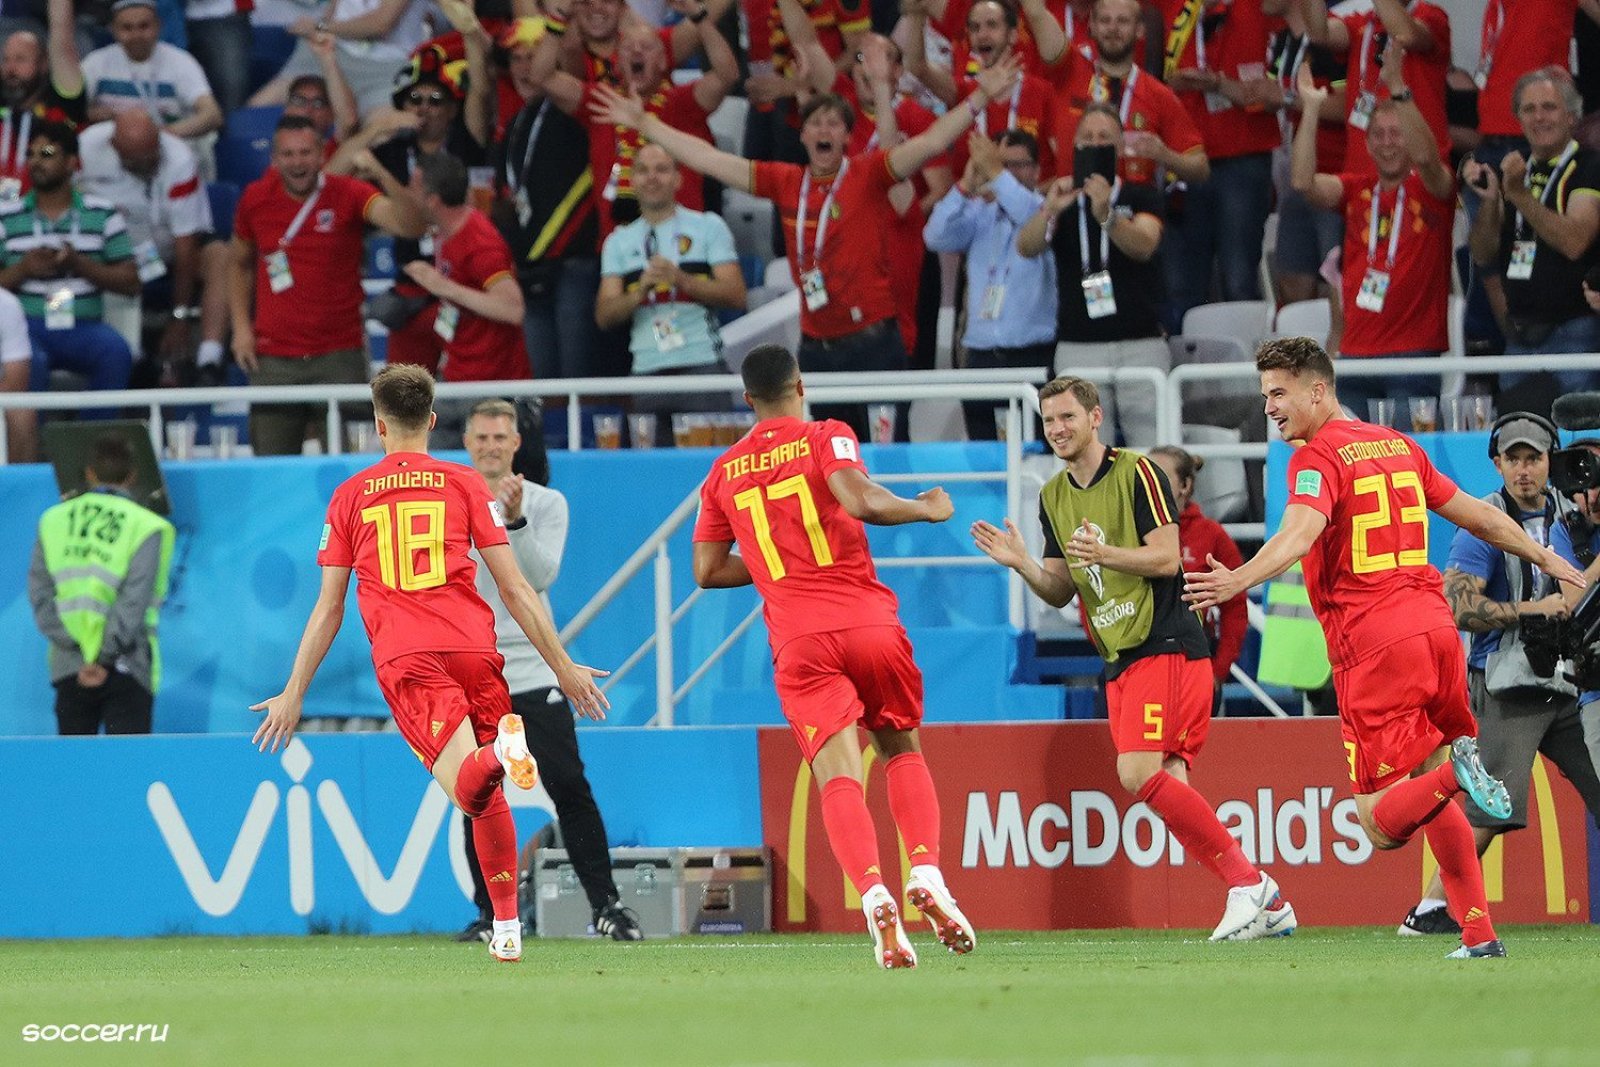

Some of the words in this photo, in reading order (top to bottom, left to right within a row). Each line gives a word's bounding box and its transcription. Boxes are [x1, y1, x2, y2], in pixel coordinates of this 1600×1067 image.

[363, 471, 446, 496] JANUZAJ
[723, 436, 811, 482] TIELEMANS
[360, 500, 448, 591] 18
[732, 473, 835, 582] 17
[1351, 470, 1429, 574] 23
[1143, 703, 1164, 741] 5
[961, 786, 1375, 869] McDoald's
